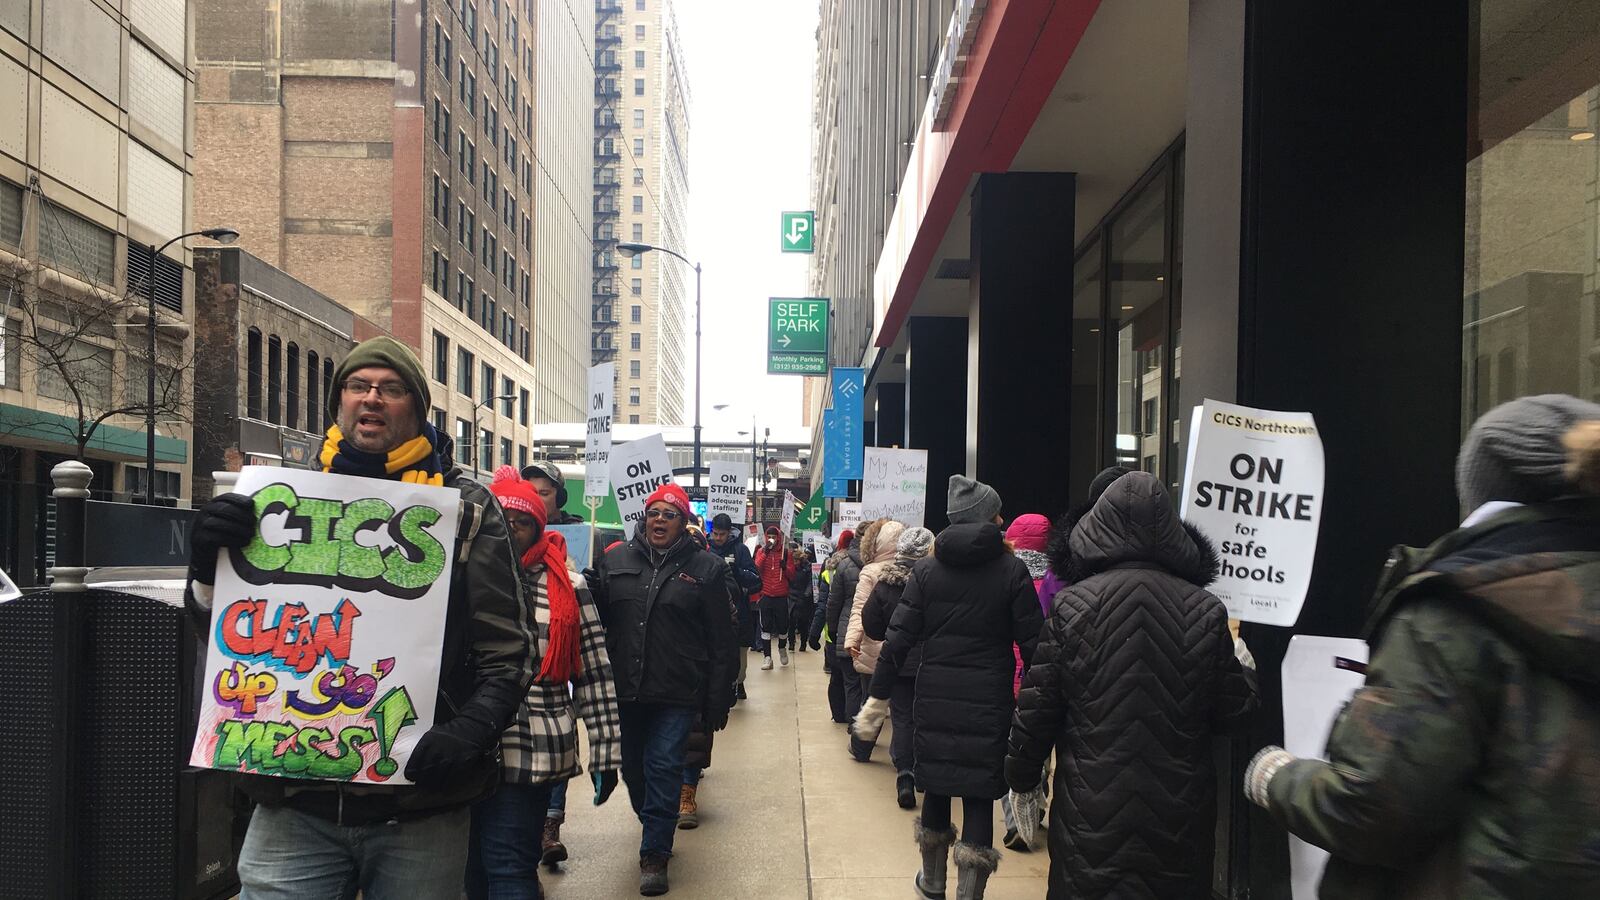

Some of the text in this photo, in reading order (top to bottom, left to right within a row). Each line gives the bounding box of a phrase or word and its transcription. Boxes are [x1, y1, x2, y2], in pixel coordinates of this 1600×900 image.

[777, 303, 819, 317] SELF
[777, 319, 820, 332] PARK
[772, 355, 825, 364] Monthly Parking
[593, 392, 604, 410] ON
[587, 415, 611, 435] STRIKE
[1213, 412, 1242, 427] CICS
[586, 449, 609, 464] equal pay
[626, 460, 652, 478] ON
[869, 456, 888, 479] My
[1230, 453, 1283, 485] ON
[617, 473, 670, 501] STRIKE
[721, 474, 737, 483] ON
[710, 484, 746, 495] STRIKE
[713, 504, 739, 513] staffing
[1195, 481, 1314, 522] STRIKE
[168, 519, 187, 556] N
[1235, 522, 1258, 538] for
[229, 482, 446, 600] CICS
[1221, 540, 1267, 559] safe
[1218, 559, 1285, 584] hools
[215, 596, 362, 679] CLEAN
[211, 685, 419, 783] MESS!
